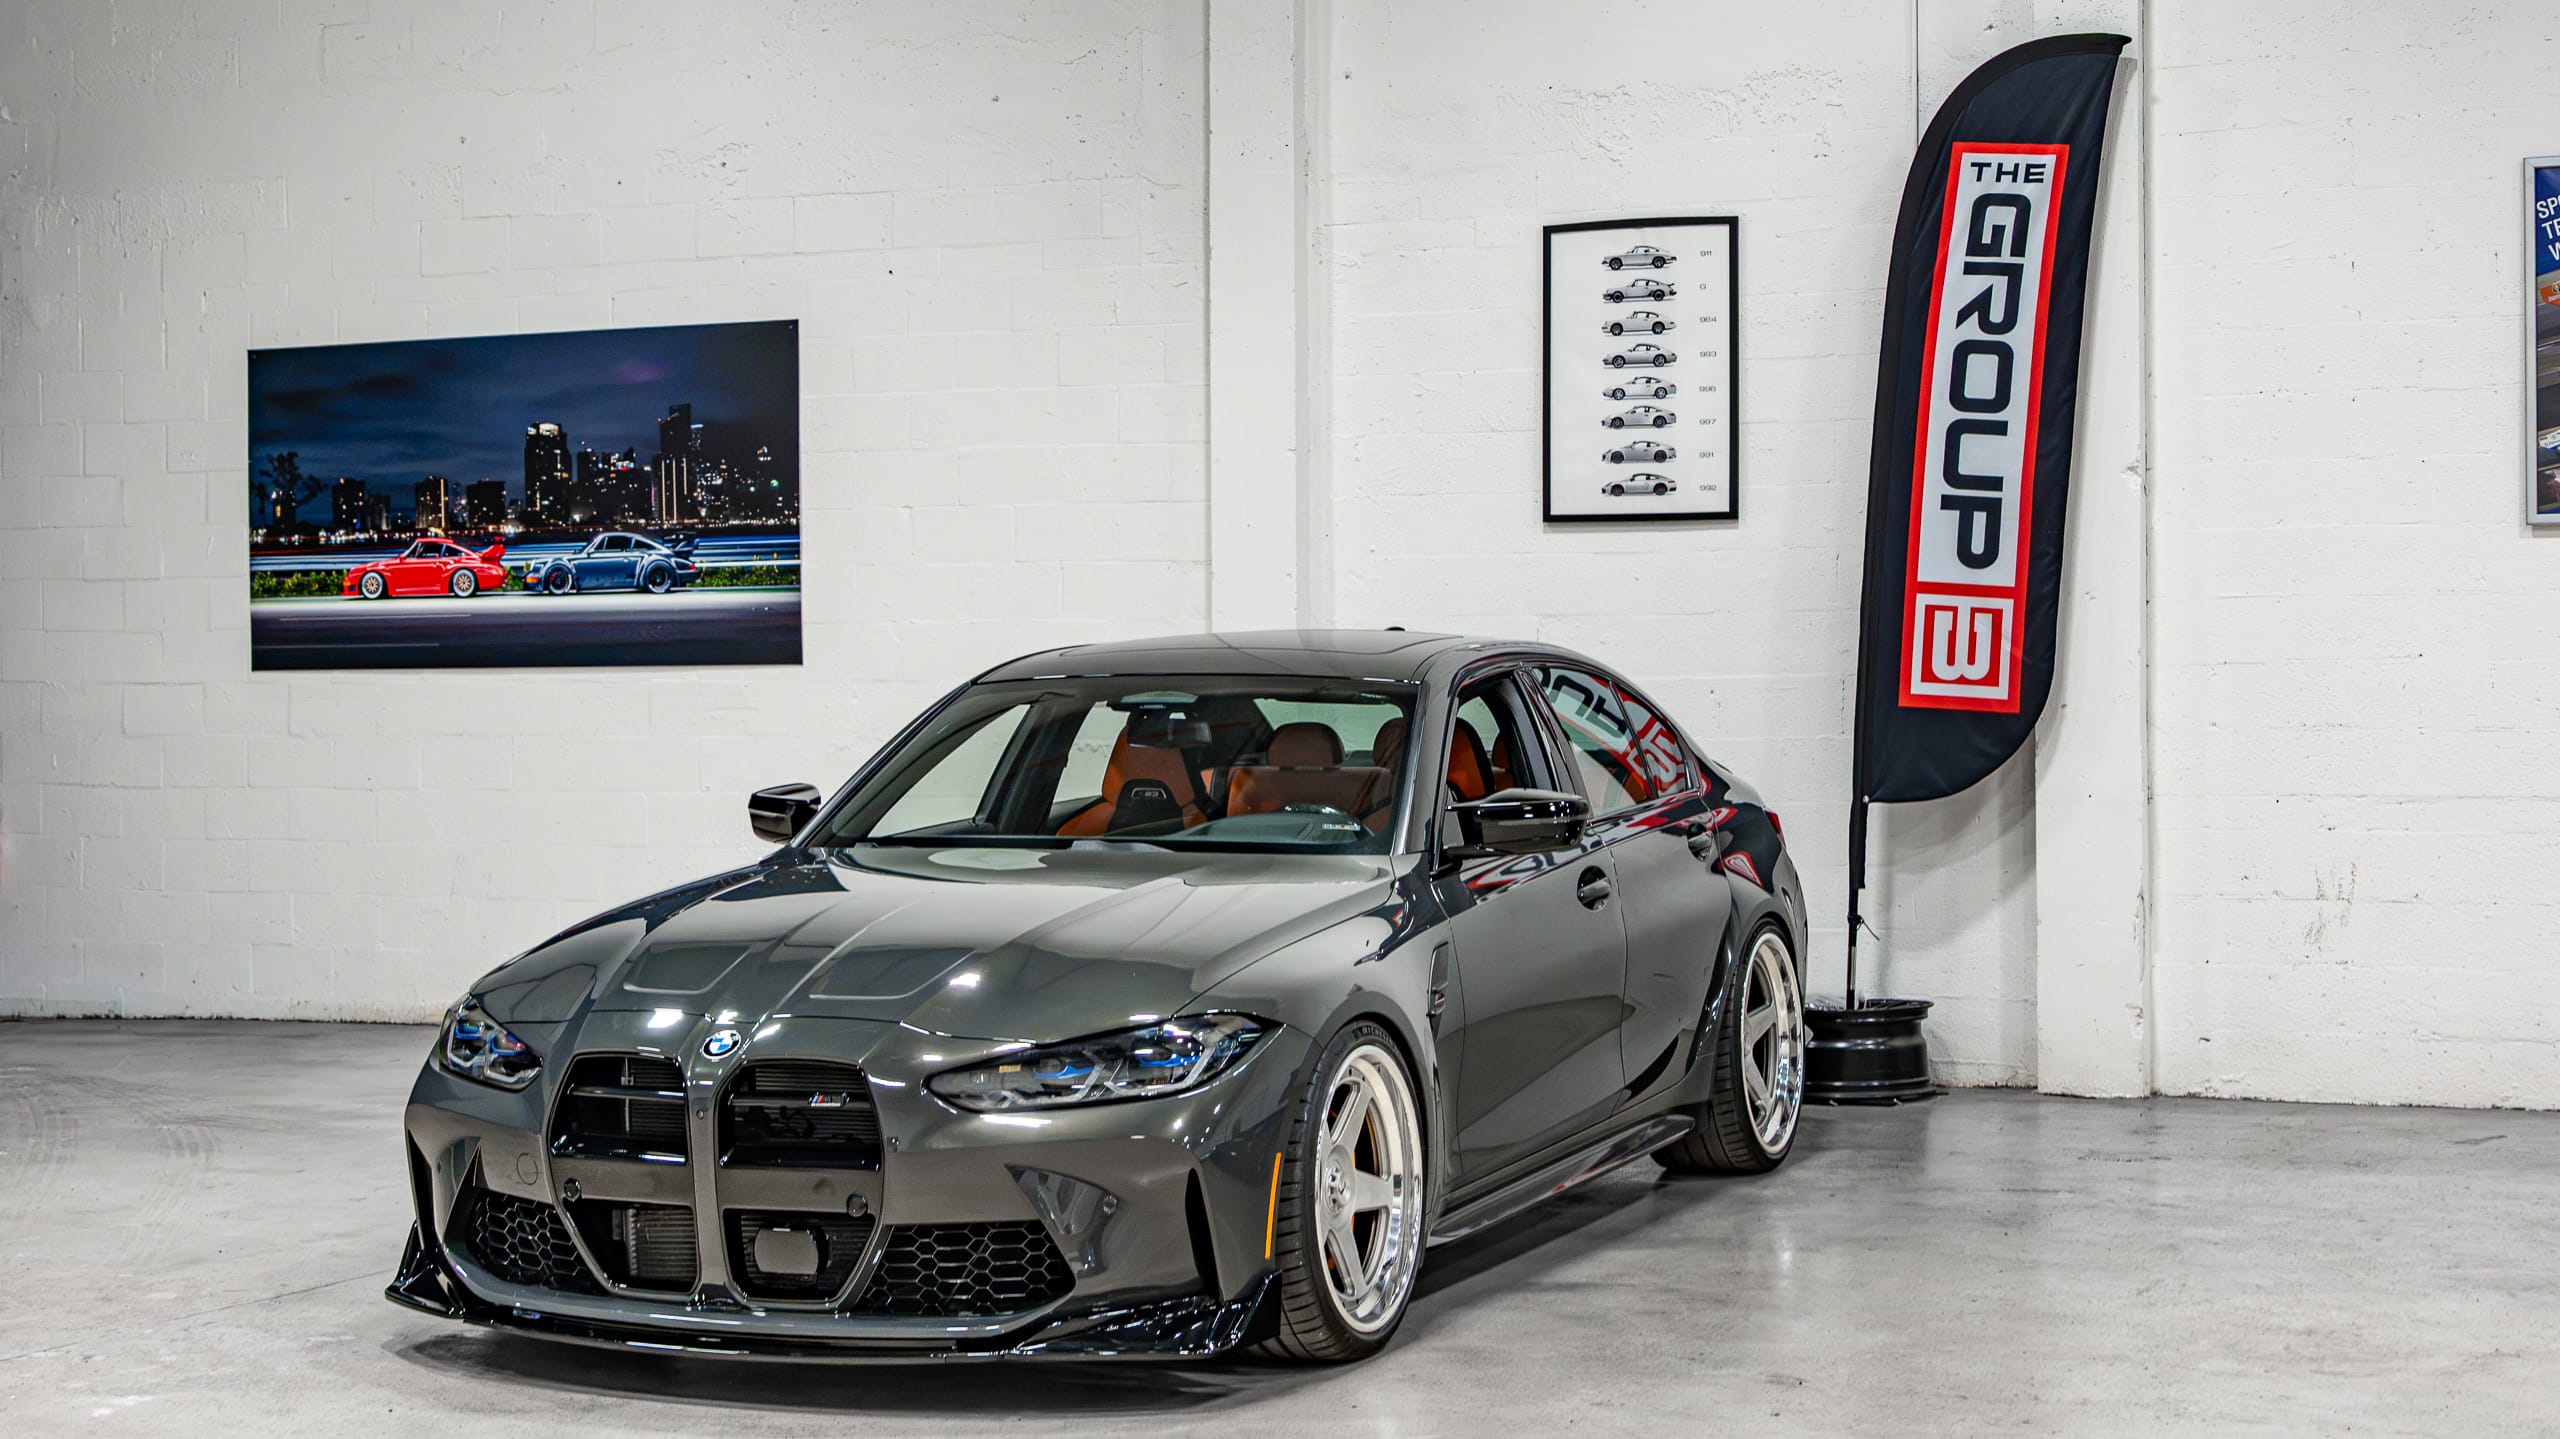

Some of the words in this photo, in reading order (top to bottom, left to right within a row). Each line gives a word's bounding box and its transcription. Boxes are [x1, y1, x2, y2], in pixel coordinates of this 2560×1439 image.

[1970, 162, 2046, 183] THE
[2536, 194, 2560, 219] SP
[1940, 193, 2032, 569] GROUP
